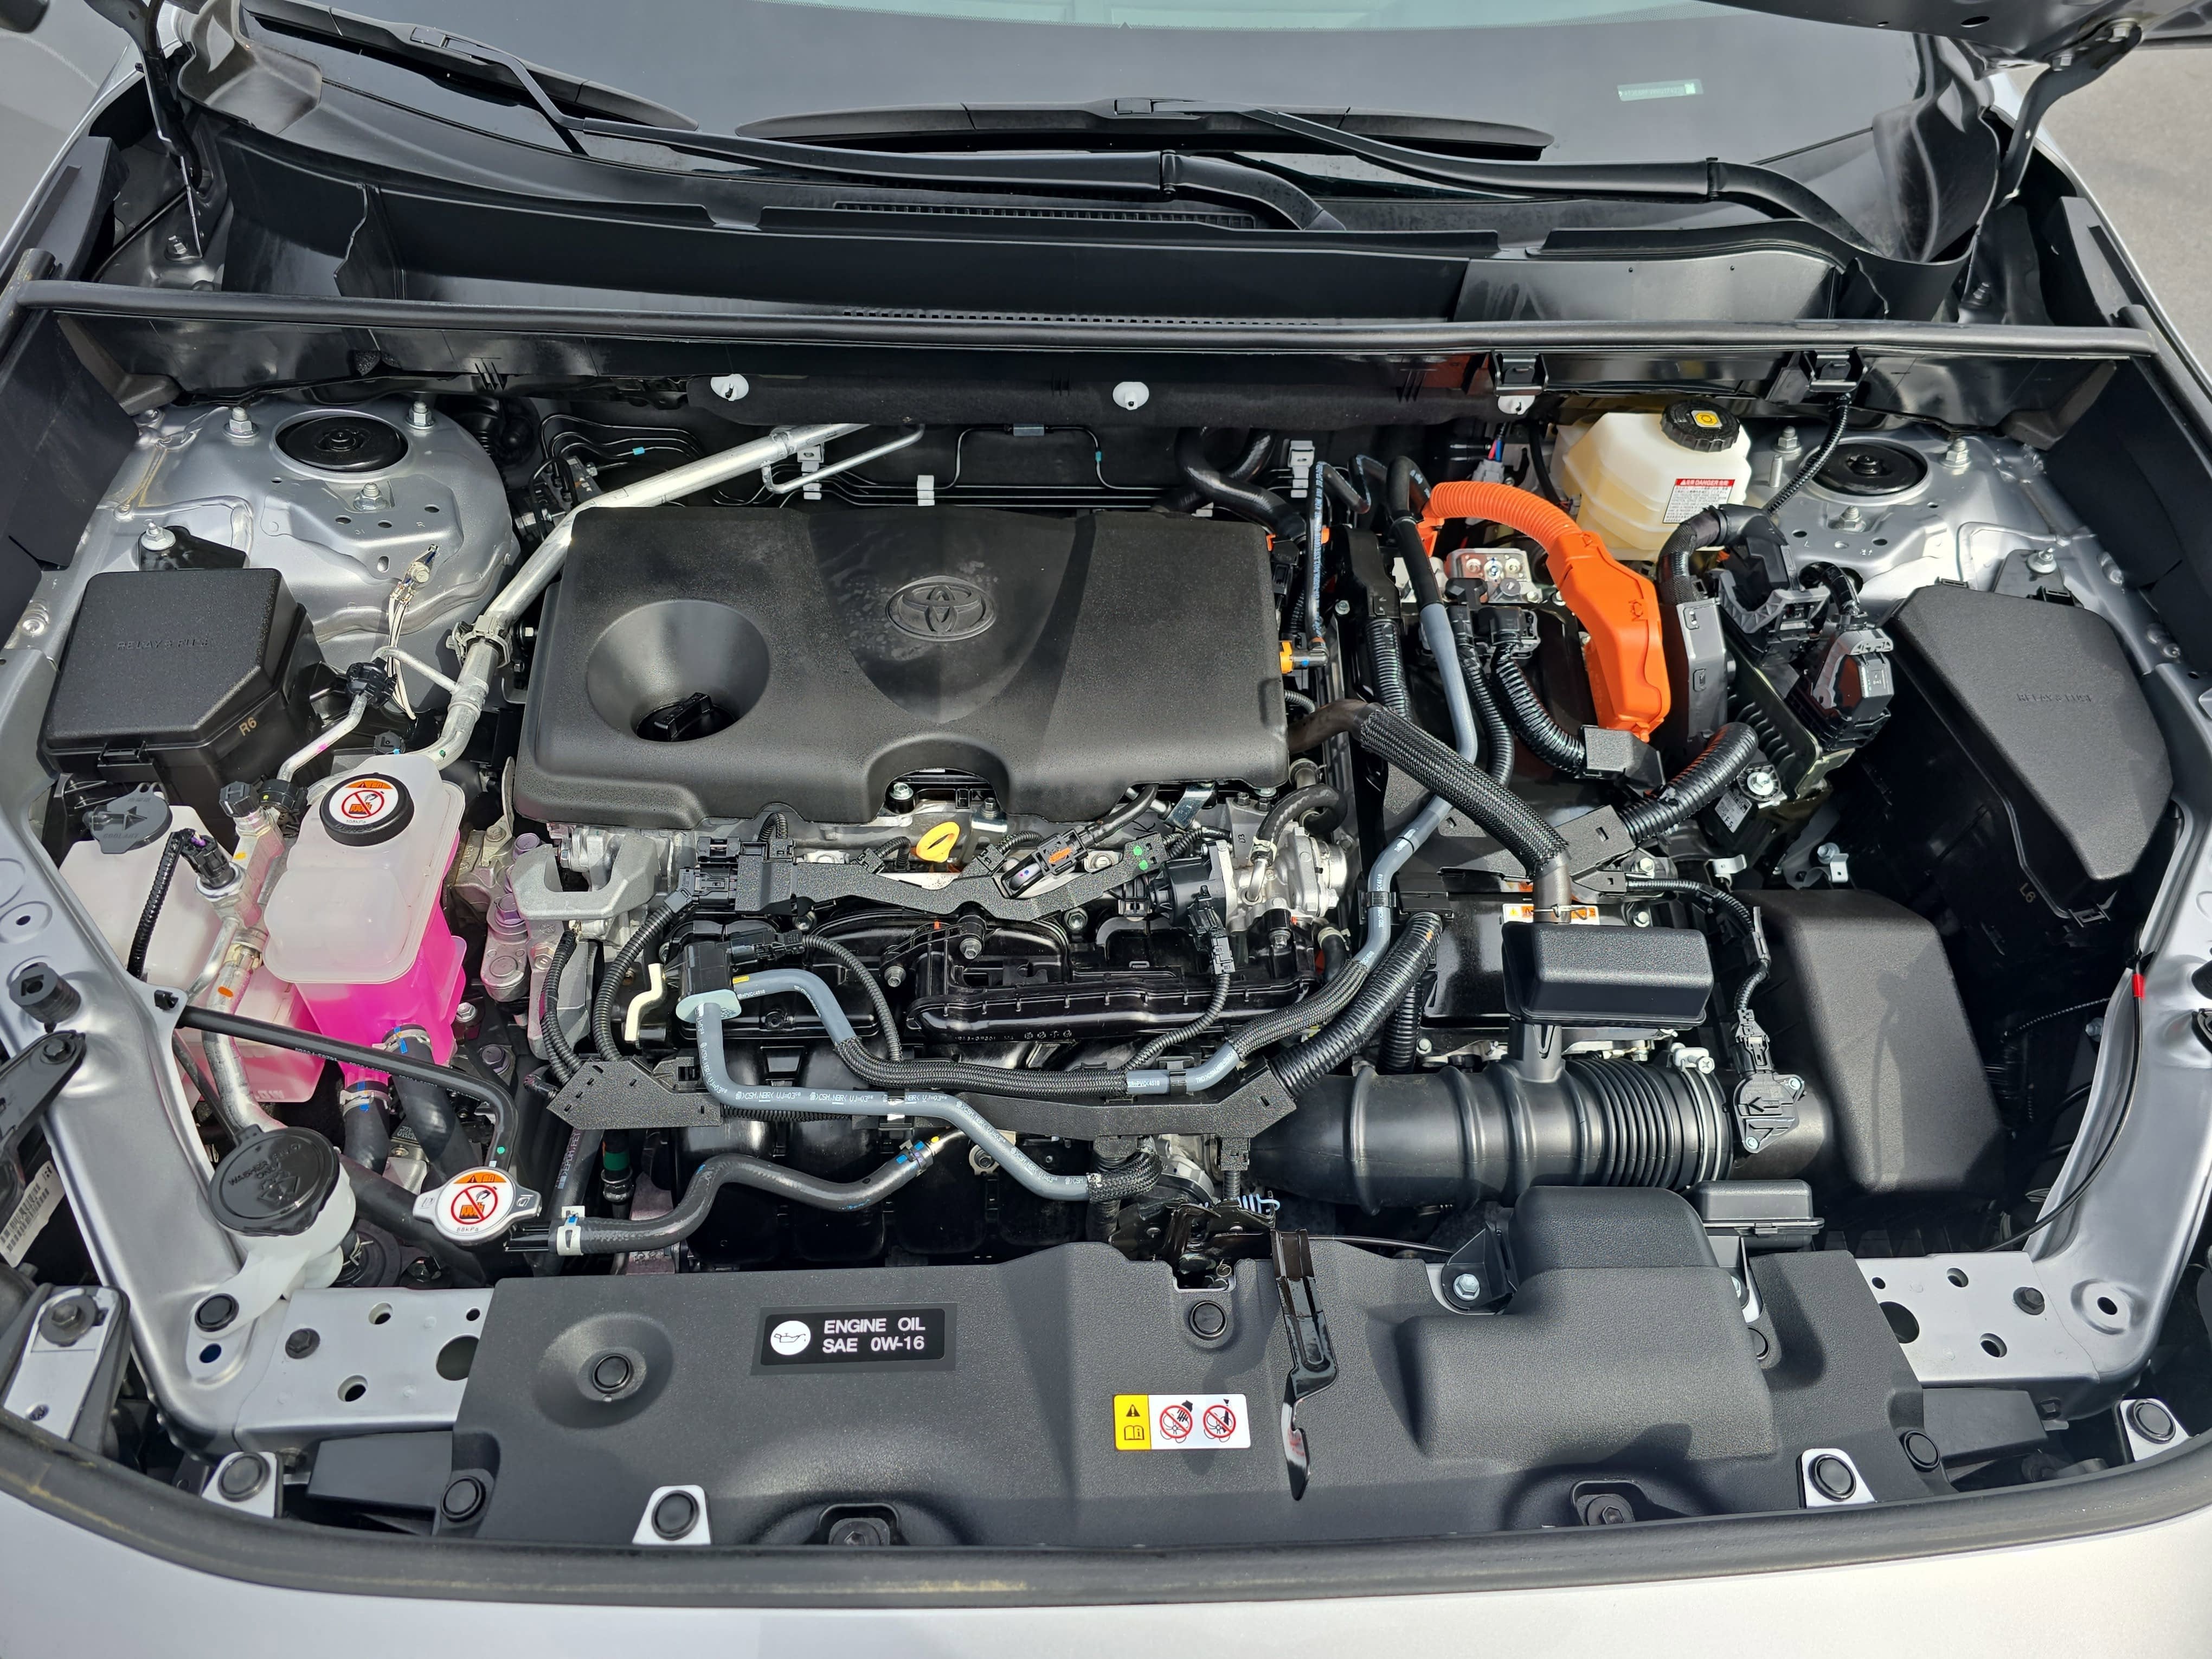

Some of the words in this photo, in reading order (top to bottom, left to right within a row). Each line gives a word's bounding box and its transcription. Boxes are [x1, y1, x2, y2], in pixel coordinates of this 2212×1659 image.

[117, 640, 163, 651] RELAY
[239, 717, 257, 736] R6
[2020, 883, 2036, 903] L6
[228, 1160, 269, 1186] WASHER
[824, 1318, 886, 1334] ENGINE
[897, 1316, 926, 1332] OIL
[822, 1337, 858, 1354] SAE
[870, 1335, 925, 1352] 0W-16
